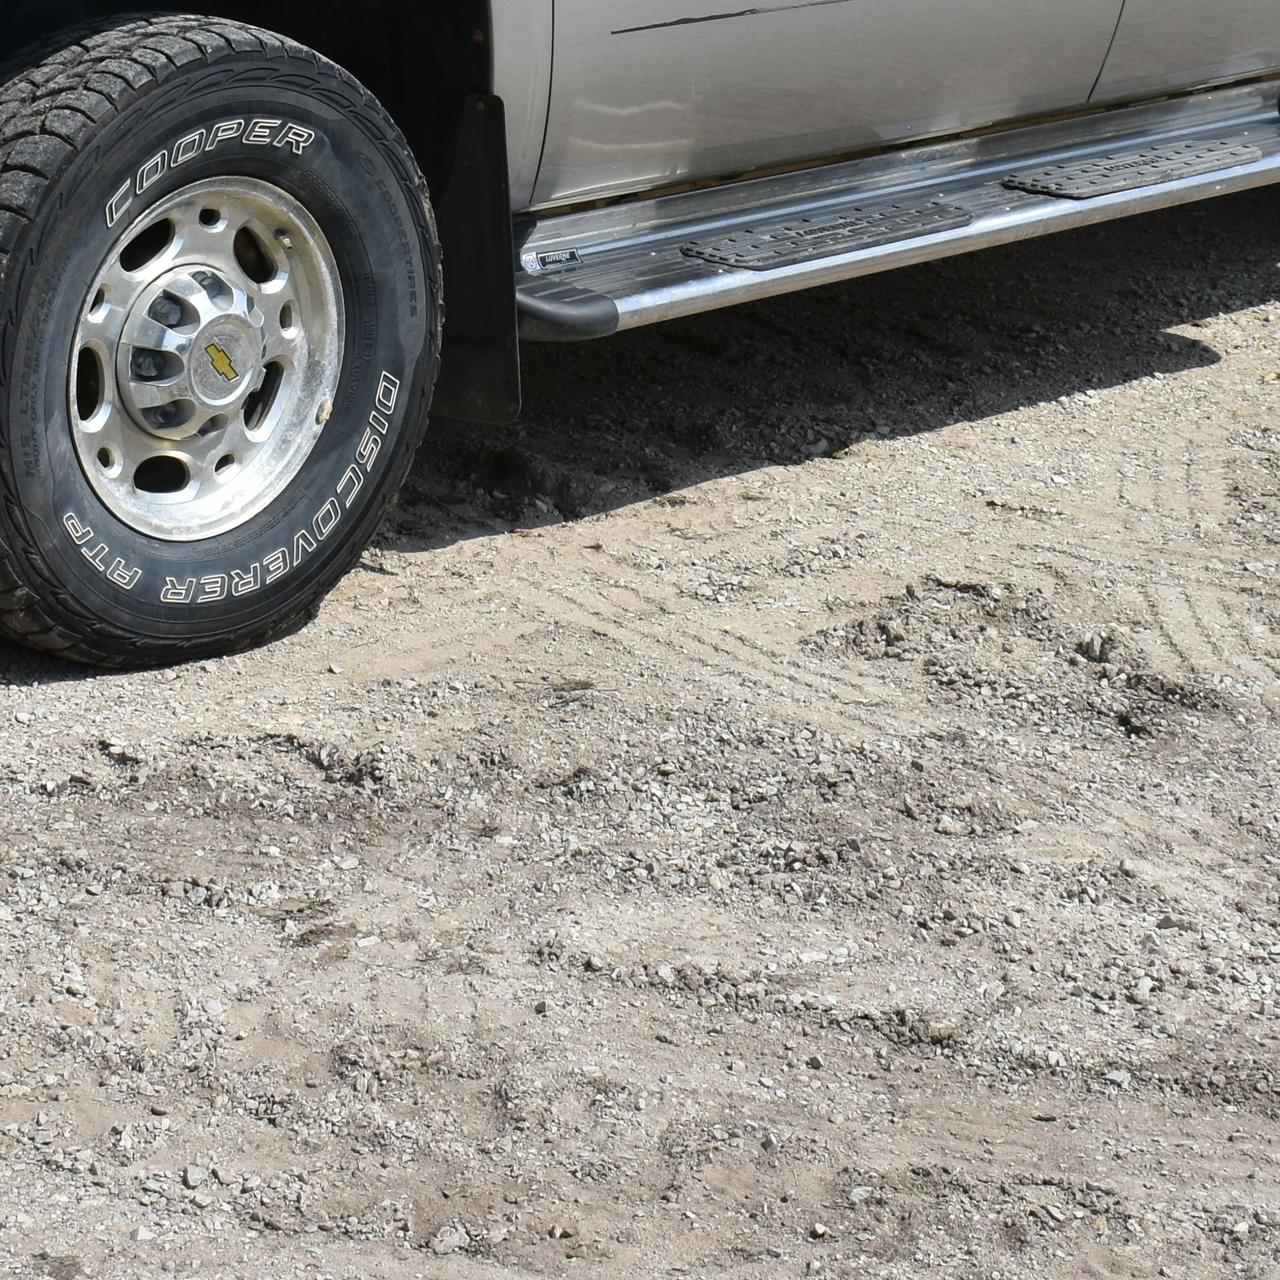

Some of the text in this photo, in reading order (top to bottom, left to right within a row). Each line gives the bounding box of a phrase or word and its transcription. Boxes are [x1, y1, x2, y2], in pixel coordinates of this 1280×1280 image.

[106, 119, 315, 229] COOPER
[160, 370, 401, 604] DISCOVERER
[63, 511, 143, 590] ATP
